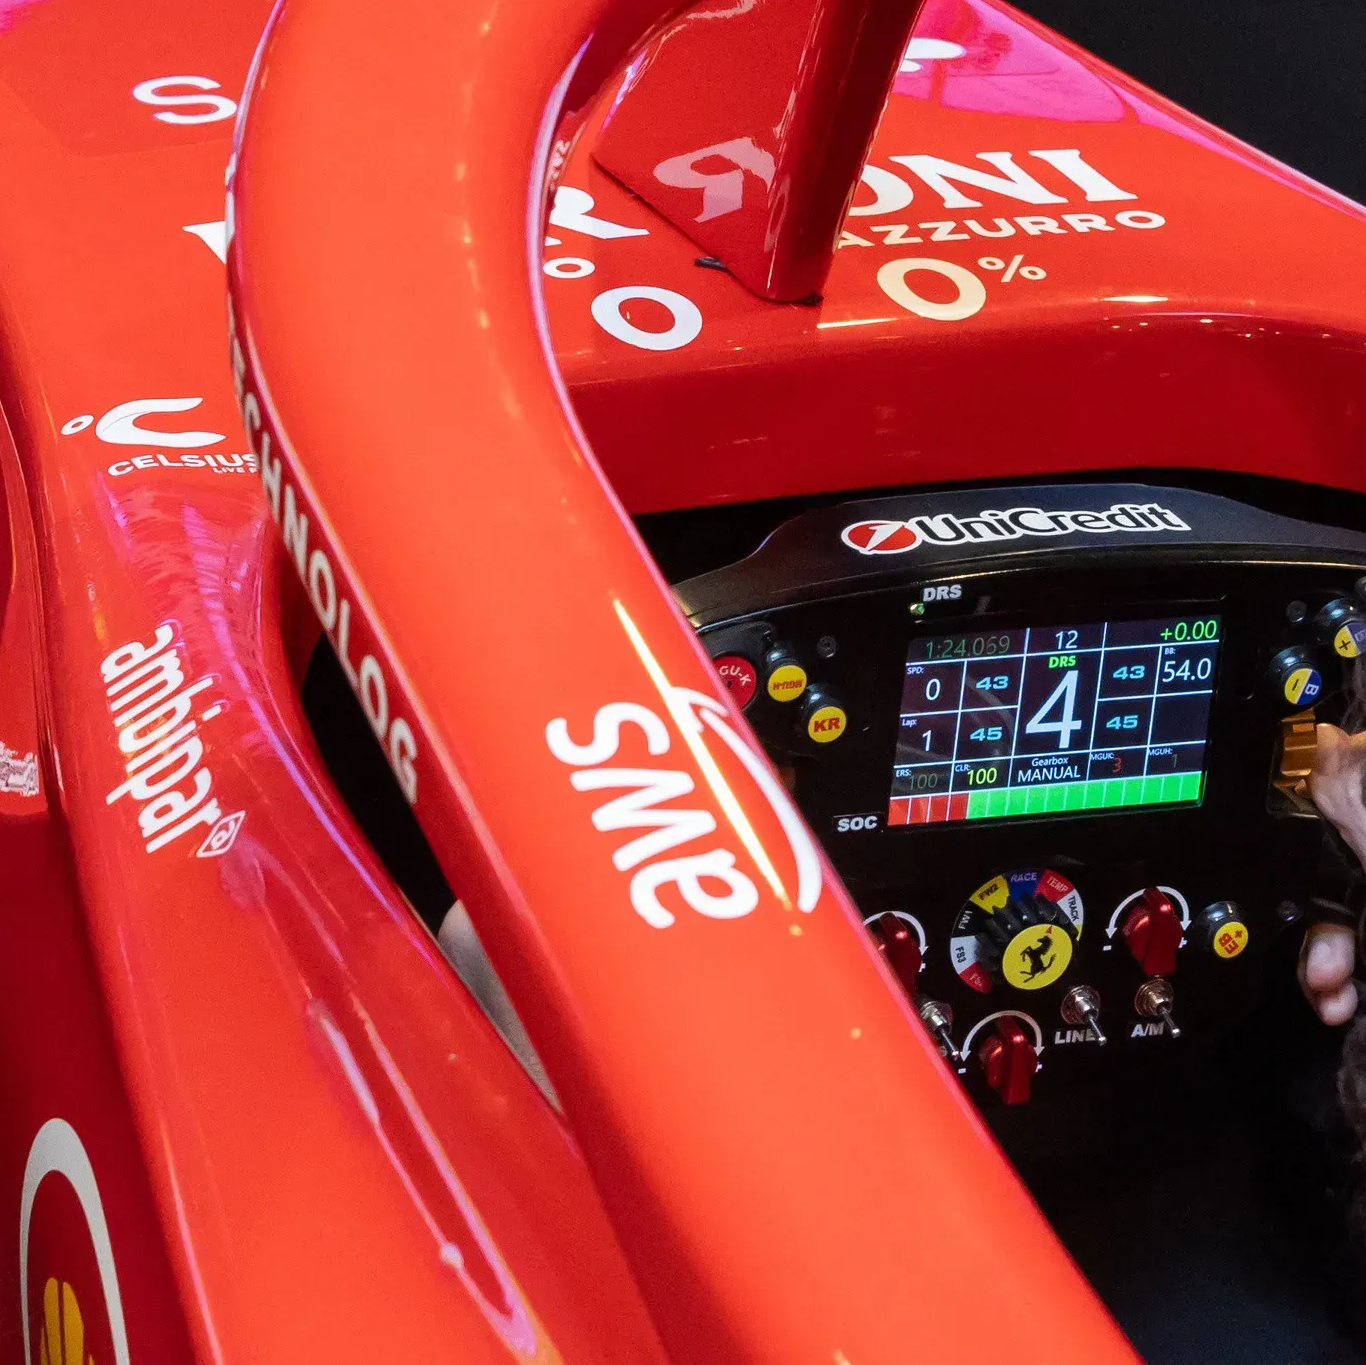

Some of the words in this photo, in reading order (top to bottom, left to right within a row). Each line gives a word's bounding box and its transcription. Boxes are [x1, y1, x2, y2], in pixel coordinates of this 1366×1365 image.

[912, 503, 1189, 545] UniCredit
[922, 584, 963, 603] DRS
[926, 635, 1011, 660] 1:24.069
[1055, 630, 1079, 649] 12
[1160, 620, 1218, 642] +0.00
[906, 666, 925, 675] SPD:
[1048, 655, 1077, 669] DRS
[1161, 657, 1212, 683] 54.0
[719, 665, 752, 686] GU-K
[1112, 665, 1146, 680] 43
[925, 678, 941, 701] 0
[975, 675, 1010, 691] 43
[1024, 669, 1083, 749] 4
[813, 717, 841, 733] KR
[902, 718, 918, 728] Lap:
[1105, 714, 1139, 730] 45
[100, 624, 223, 854] ambipar
[922, 729, 932, 752] 1
[969, 726, 1003, 742] 45
[1031, 756, 1070, 767] Gearbox
[895, 769, 912, 778] ERS:
[967, 767, 998, 786] 100
[1016, 765, 1081, 783] MANUAL
[544, 701, 760, 930] aws
[837, 815, 878, 834] SOC
[1010, 872, 1037, 883] RACE
[1046, 876, 1069, 893] TEMP
[1067, 894, 1080, 922] TRACK
